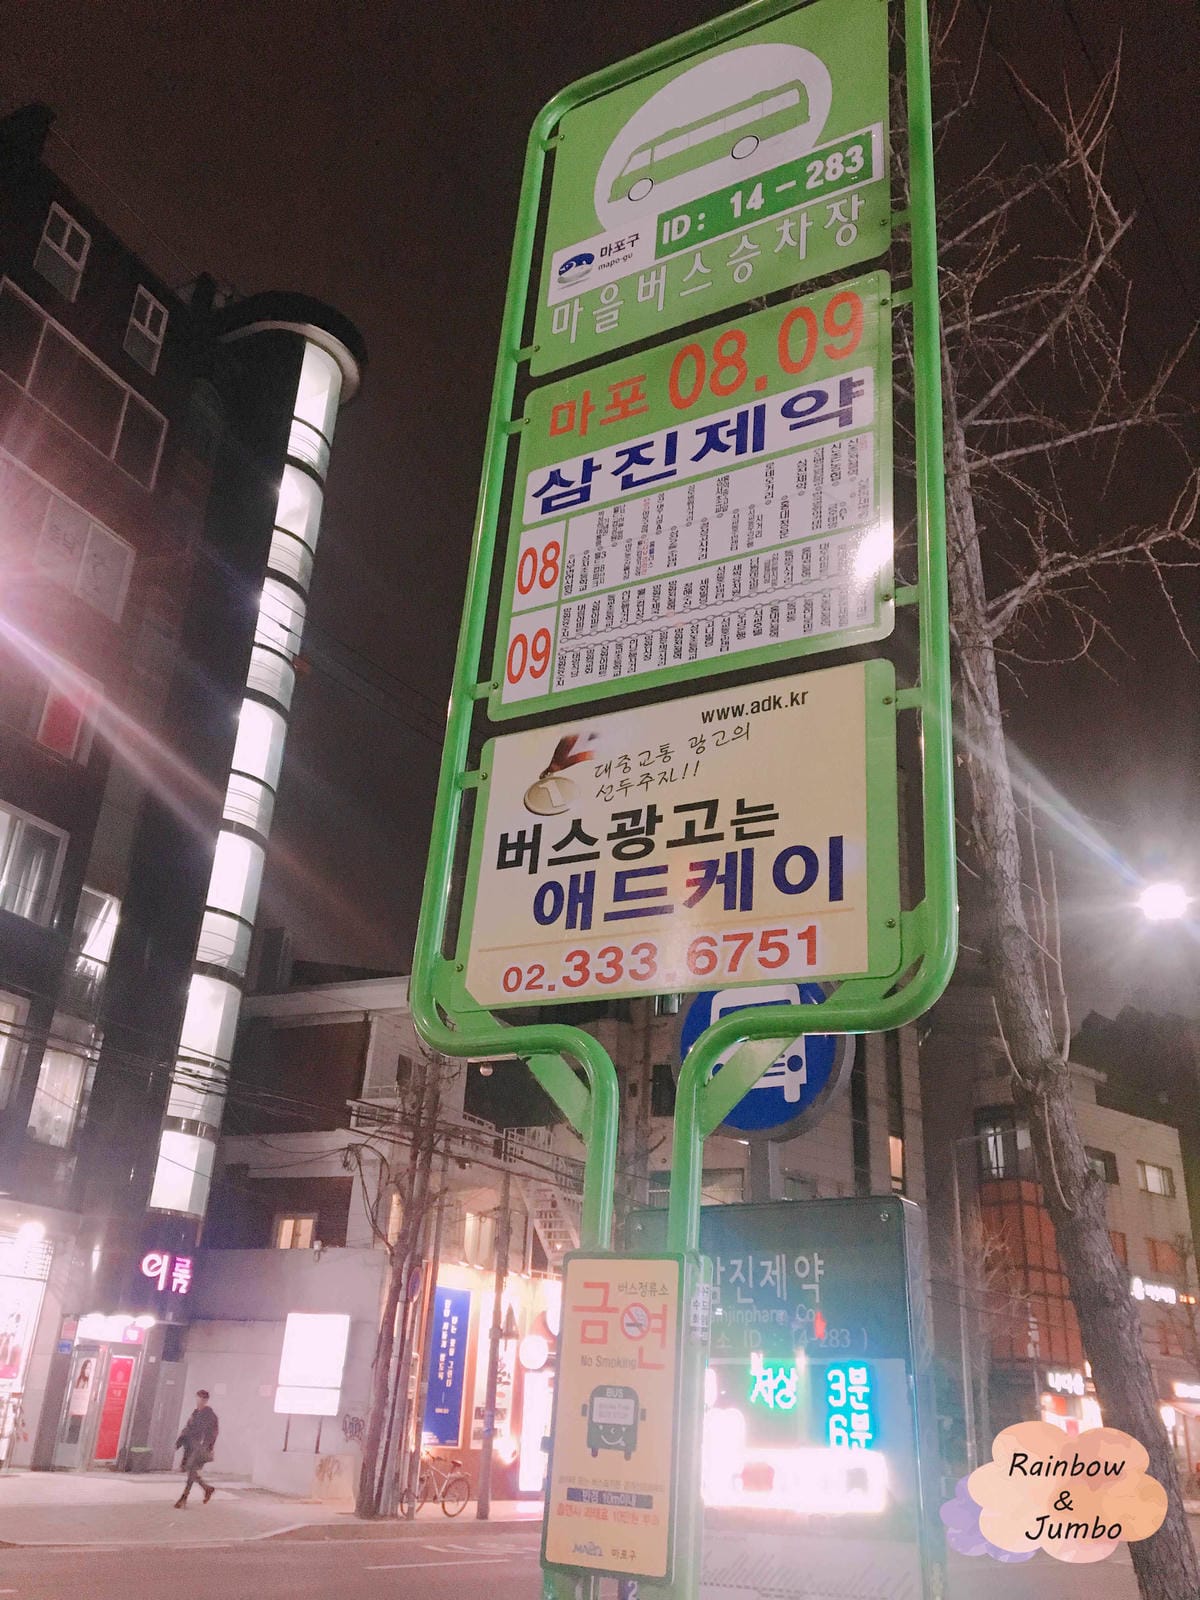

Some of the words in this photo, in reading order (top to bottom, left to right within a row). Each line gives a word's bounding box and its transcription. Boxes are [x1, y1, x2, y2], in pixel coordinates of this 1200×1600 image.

[662, 213, 705, 245] ID:
[730, 182, 765, 218] 14
[805, 144, 865, 190] 283
[600, 233, 640, 257] 마포구
[549, 374, 650, 437] 마포
[531, 376, 865, 515] 삼진제약
[517, 540, 561, 595] 08
[507, 627, 552, 684] 09
[701, 690, 809, 724] www.adk.kr
[595, 743, 675, 779] 대중교통
[688, 722, 750, 755] 광고의
[496, 798, 780, 876] 버스광고는
[532, 835, 844, 931] 애드케이
[617, 1281, 670, 1298] 버스정류소
[580, 1355, 593, 1367] No
[595, 1355, 637, 1370] Smoking
[606, 1387, 624, 1398] BUS
